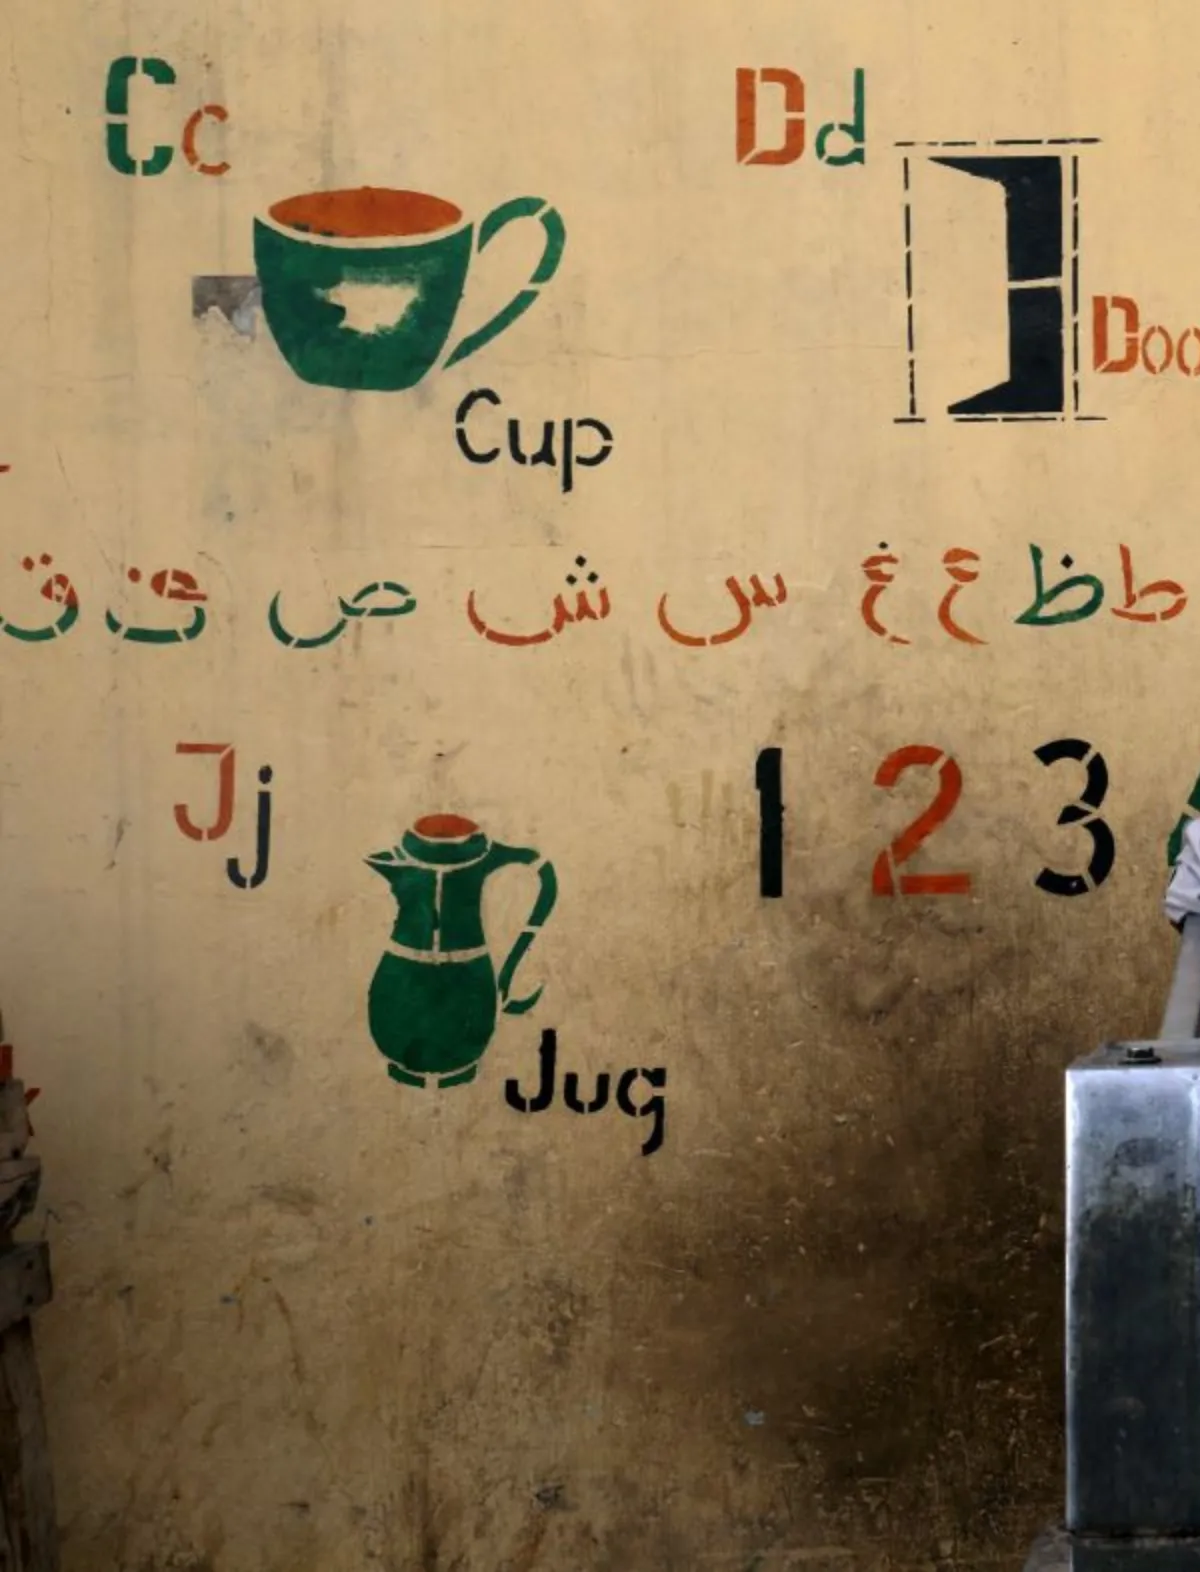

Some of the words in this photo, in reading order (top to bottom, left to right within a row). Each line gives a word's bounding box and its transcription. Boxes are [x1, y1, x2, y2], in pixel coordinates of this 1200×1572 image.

[455, 388, 613, 494] Cup
[268, 582, 416, 648] ص
[468, 555, 610, 646] ش
[658, 574, 787, 646] س
[861, 541, 911, 644] غ
[938, 548, 986, 644] ع
[1014, 544, 1104, 626] ظ
[1111, 544, 1187, 622] ط
[755, 747, 783, 898] 1
[872, 744, 971, 896] 2
[1033, 738, 1116, 896] 3
[505, 1028, 667, 1156] Jug
